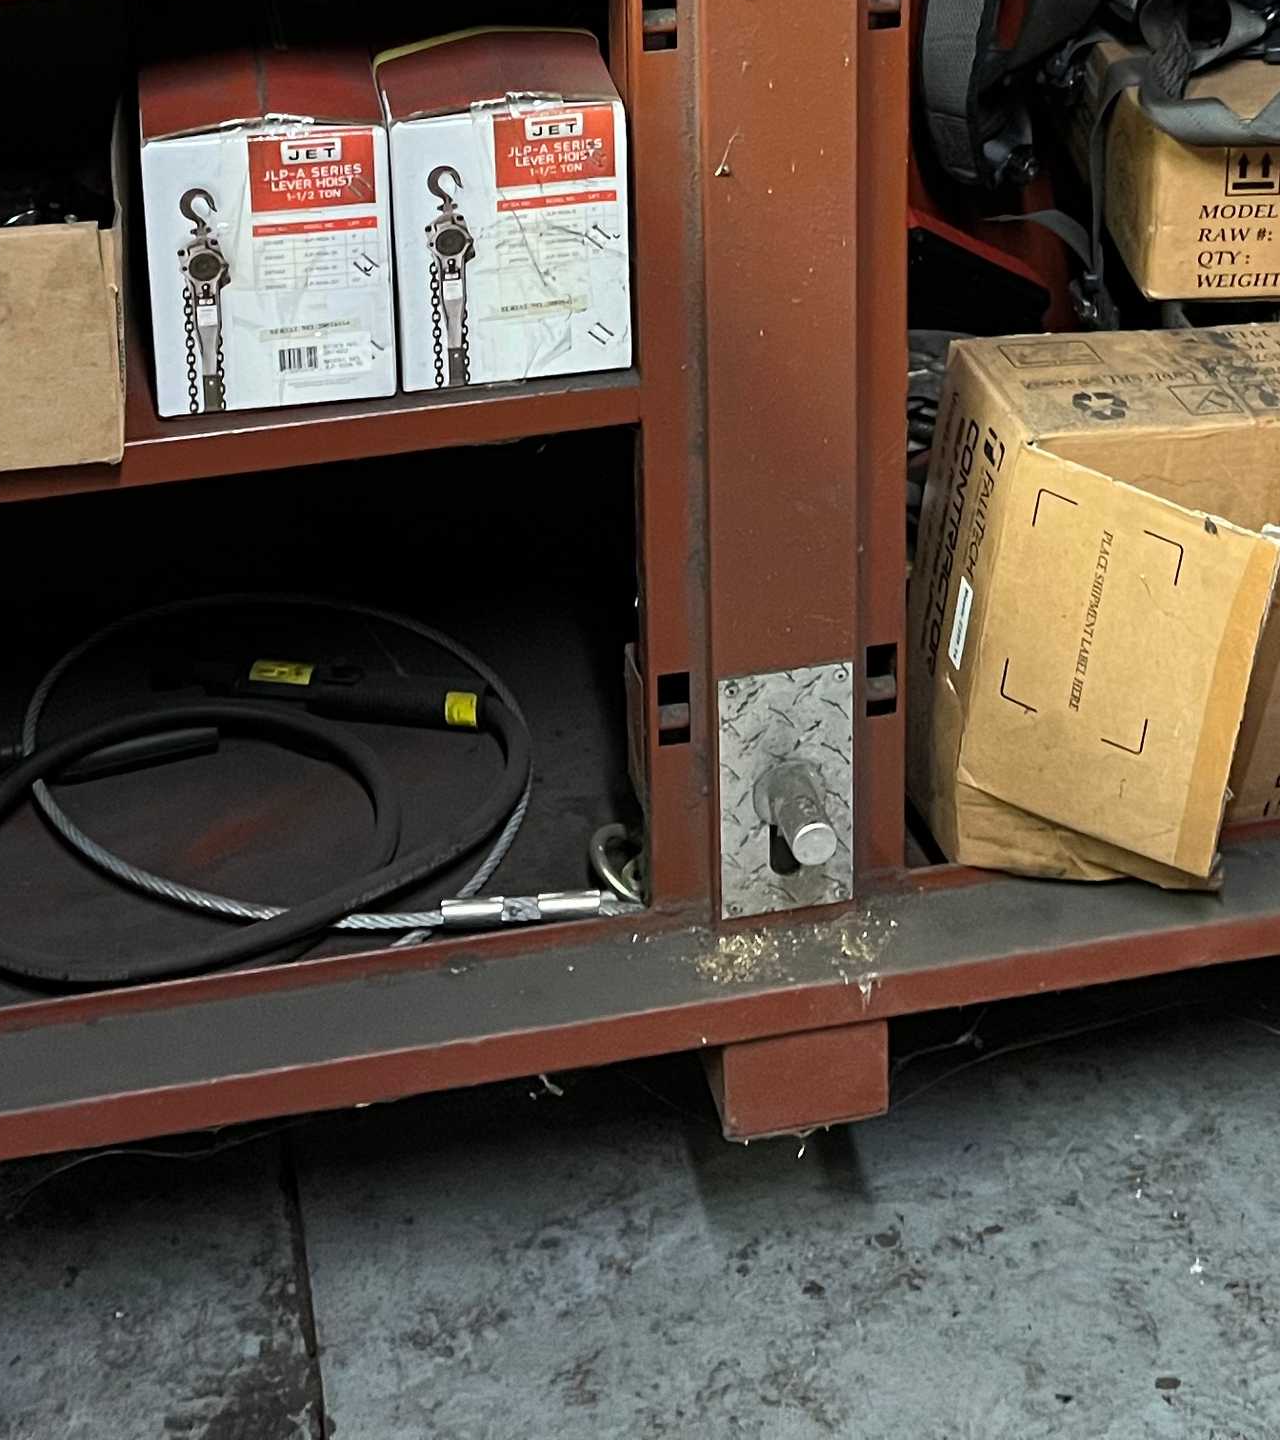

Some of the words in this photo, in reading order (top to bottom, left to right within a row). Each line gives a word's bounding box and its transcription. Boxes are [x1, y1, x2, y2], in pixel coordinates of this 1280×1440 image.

[531, 123, 578, 137] JET
[288, 147, 336, 161] JET
[508, 142, 549, 158] JLP-A
[553, 137, 604, 153] SERIES
[514, 153, 556, 168] LEVER
[558, 149, 596, 163] HOIST
[263, 168, 306, 182] JLP-A
[310, 163, 363, 178] SERIES
[560, 163, 583, 174] TON
[271, 178, 312, 192] LEVER
[315, 174, 354, 189] HOIST
[286, 190, 315, 202] 1-1/2
[319, 188, 342, 200] TON
[1198, 203, 1279, 221] MODEL
[1197, 226, 1251, 242] RAW
[1097, 528, 1114, 573] PLACE
[1083, 572, 1105, 638] SHIPMENT
[1075, 637, 1093, 678] LABEL
[1067, 676, 1085, 713] HERE
